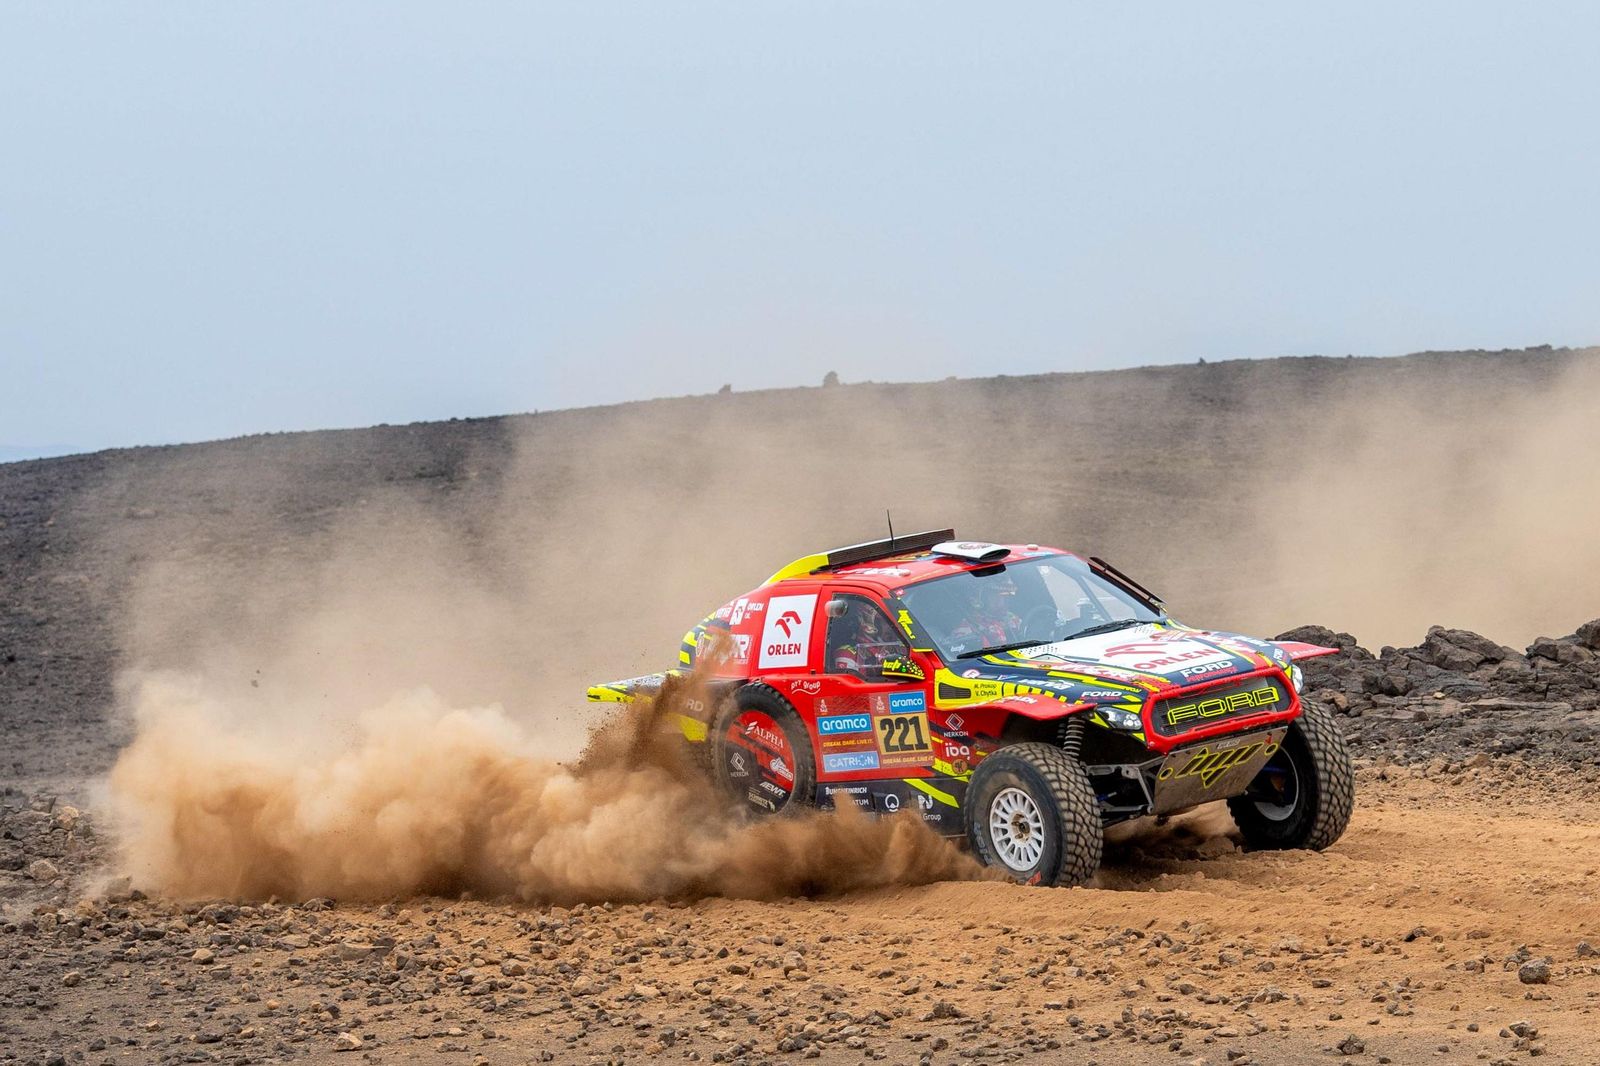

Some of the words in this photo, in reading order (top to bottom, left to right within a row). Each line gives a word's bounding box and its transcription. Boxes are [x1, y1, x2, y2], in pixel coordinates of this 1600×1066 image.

[767, 643, 801, 656] ORLEN
[1133, 648, 1221, 670] ORLEN
[1179, 660, 1233, 678] FORD
[891, 698, 923, 708] aramco
[1168, 686, 1280, 726] FORD
[822, 718, 867, 731] aramco
[754, 725, 784, 748] ALPHA
[879, 716, 929, 753] 221
[943, 730, 969, 738] NERKON
[922, 813, 942, 822] Group
